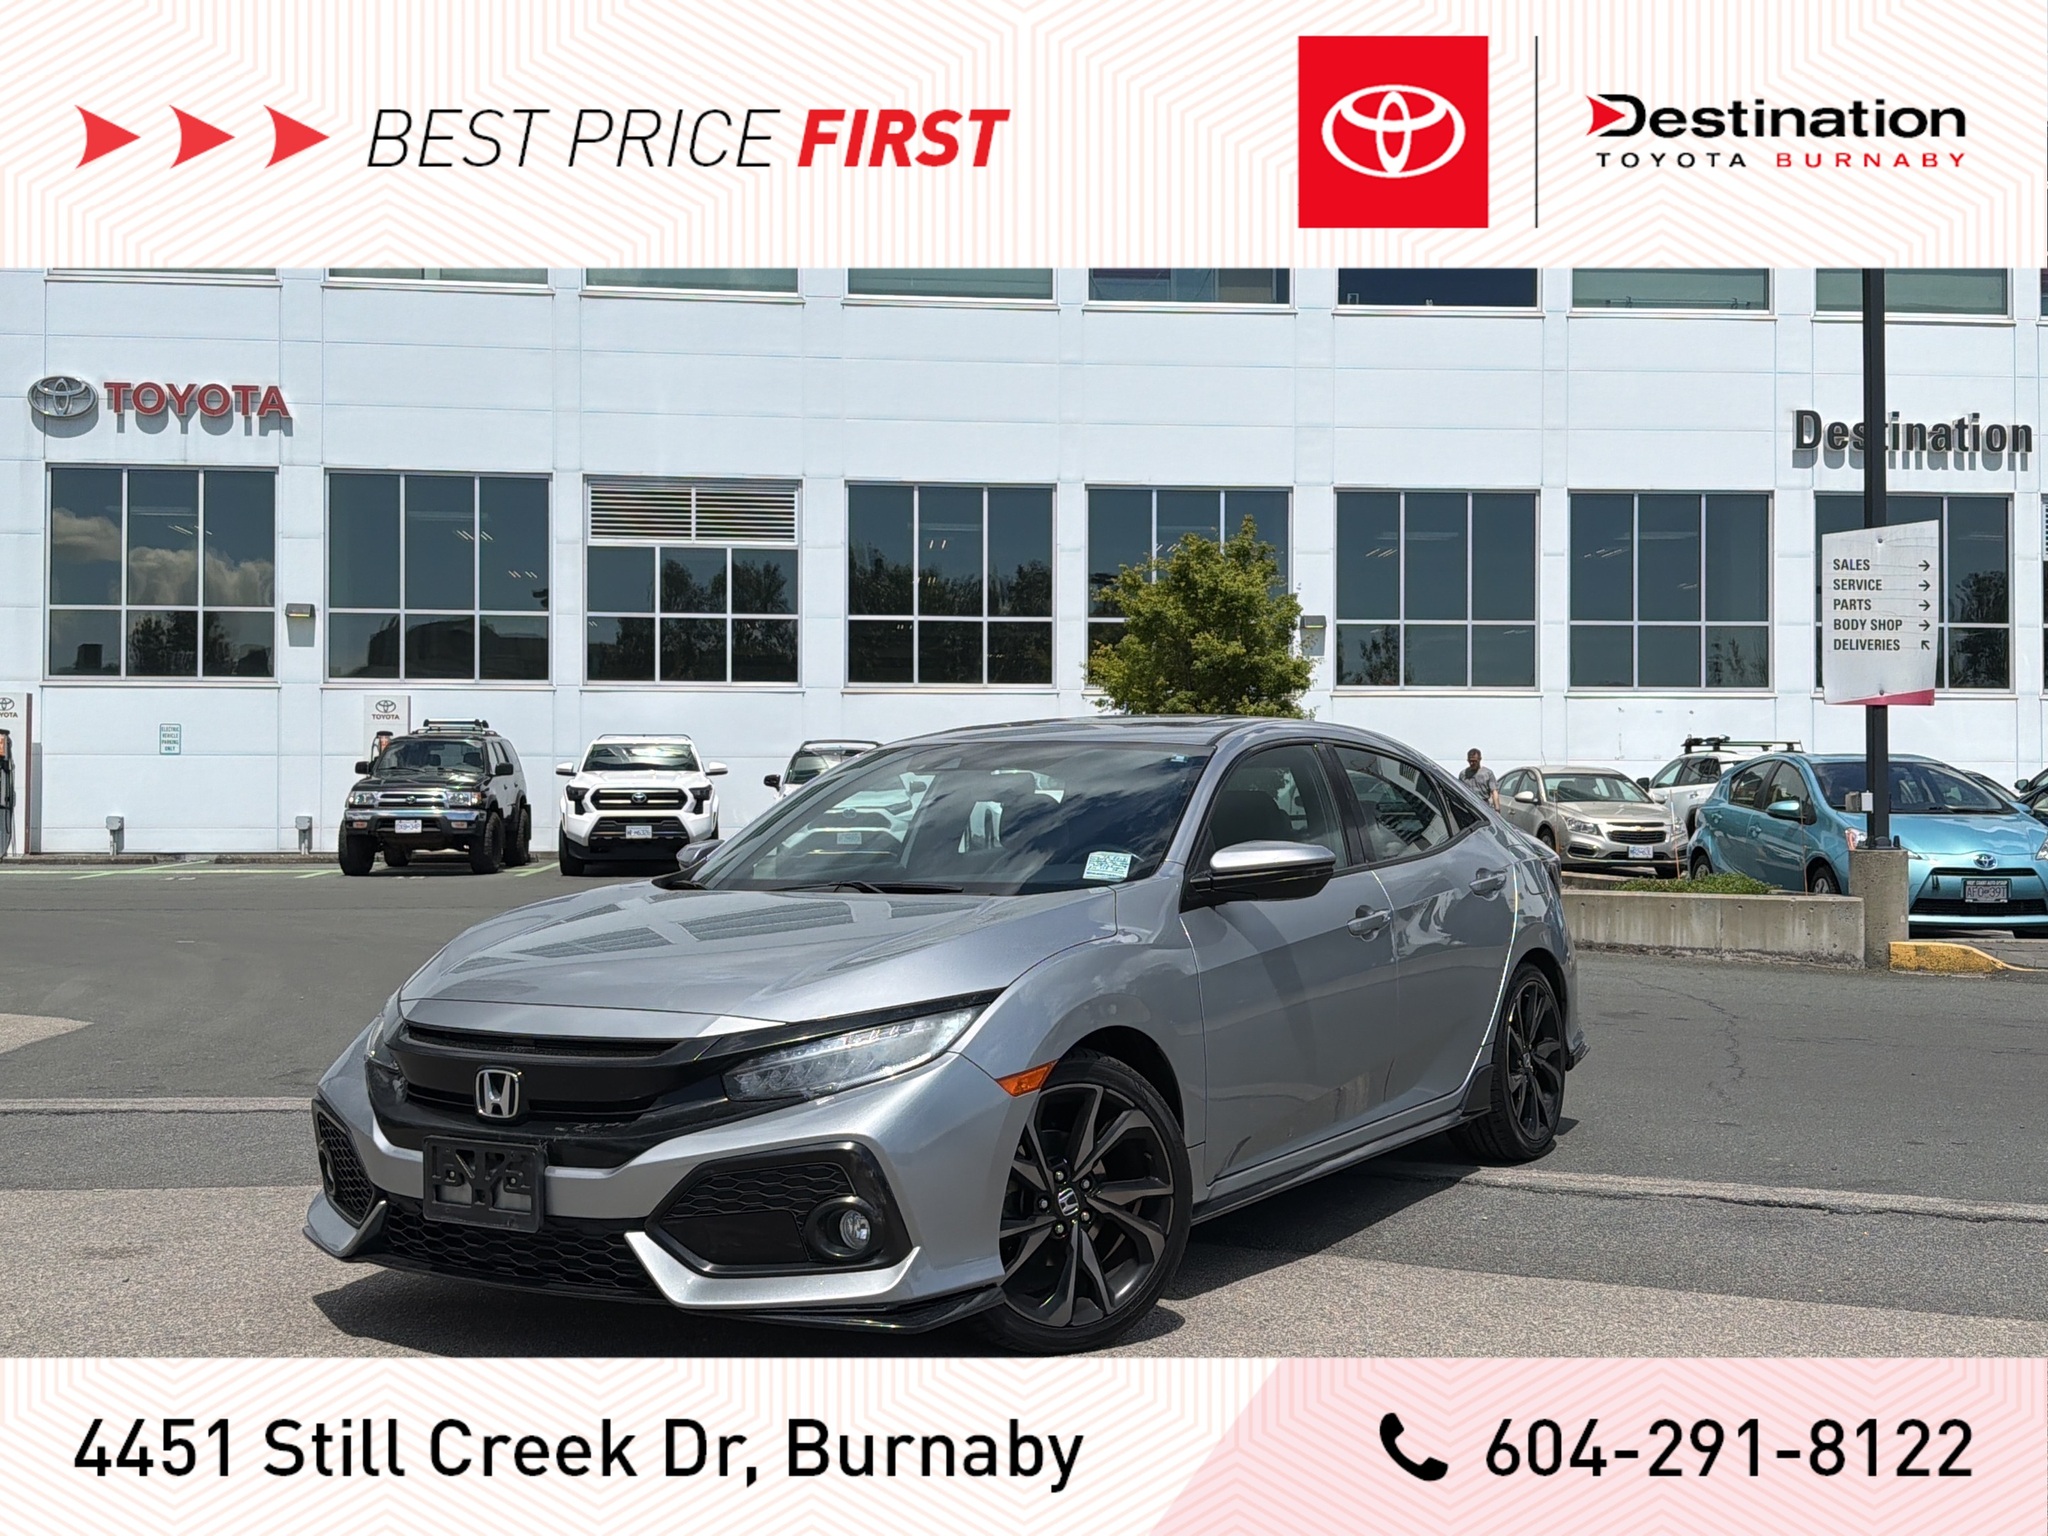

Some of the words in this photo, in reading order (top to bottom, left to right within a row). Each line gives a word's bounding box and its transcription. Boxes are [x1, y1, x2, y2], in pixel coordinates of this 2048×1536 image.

[104, 381, 290, 418] TOYOTA
[1794, 409, 2033, 453] Desination
[1833, 558, 1870, 571] SALES
[1833, 578, 1883, 591] SERVICE
[1833, 598, 1872, 611] PARTS
[1833, 618, 1867, 631] BODY
[1870, 618, 1903, 631] SHOP
[1833, 638, 1900, 651] DELIVERIES
[371, 713, 400, 721] TOYOTA
